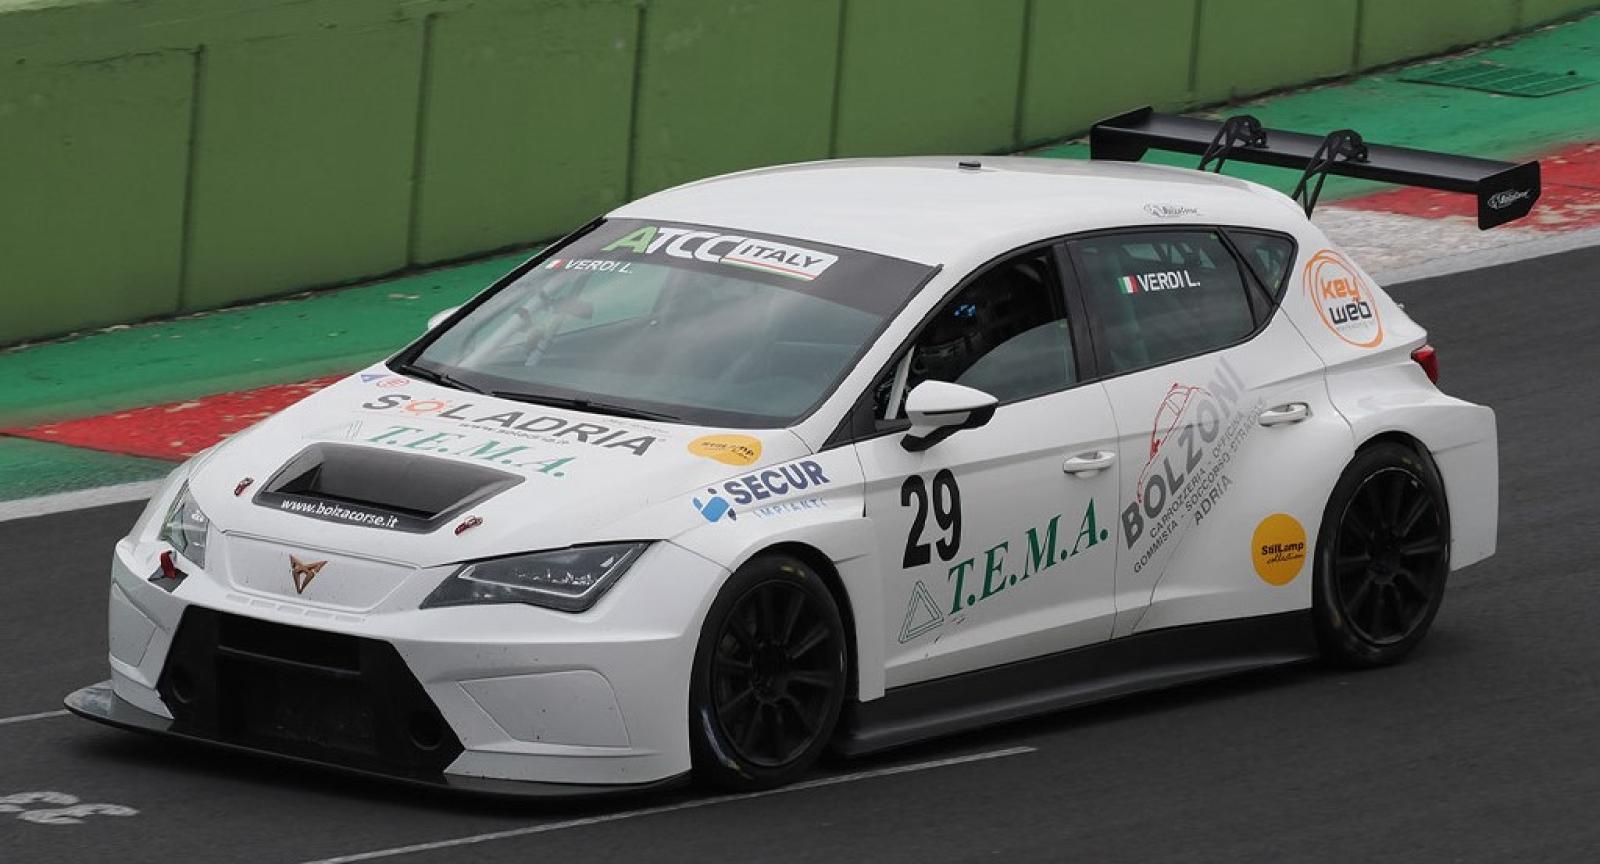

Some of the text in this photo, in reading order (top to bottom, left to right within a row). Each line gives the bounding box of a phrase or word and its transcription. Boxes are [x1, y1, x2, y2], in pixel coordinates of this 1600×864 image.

[565, 259, 633, 274] VERDI L.
[601, 226, 823, 268] ATCC ITALY
[1136, 269, 1185, 292] VERDI
[1320, 277, 1360, 303] key
[364, 425, 577, 478] T.E.M.A.
[1121, 356, 1246, 551] BOLZONI
[723, 460, 831, 505] SECUR
[1150, 467, 1206, 539] CARROZZERIA
[1194, 474, 1234, 527] ADRIA
[900, 468, 963, 570] 29
[1133, 519, 1179, 574] GOMMISTA
[1185, 450, 1232, 513] SOCCORSO
[947, 497, 1109, 616] T.E.M.A.
